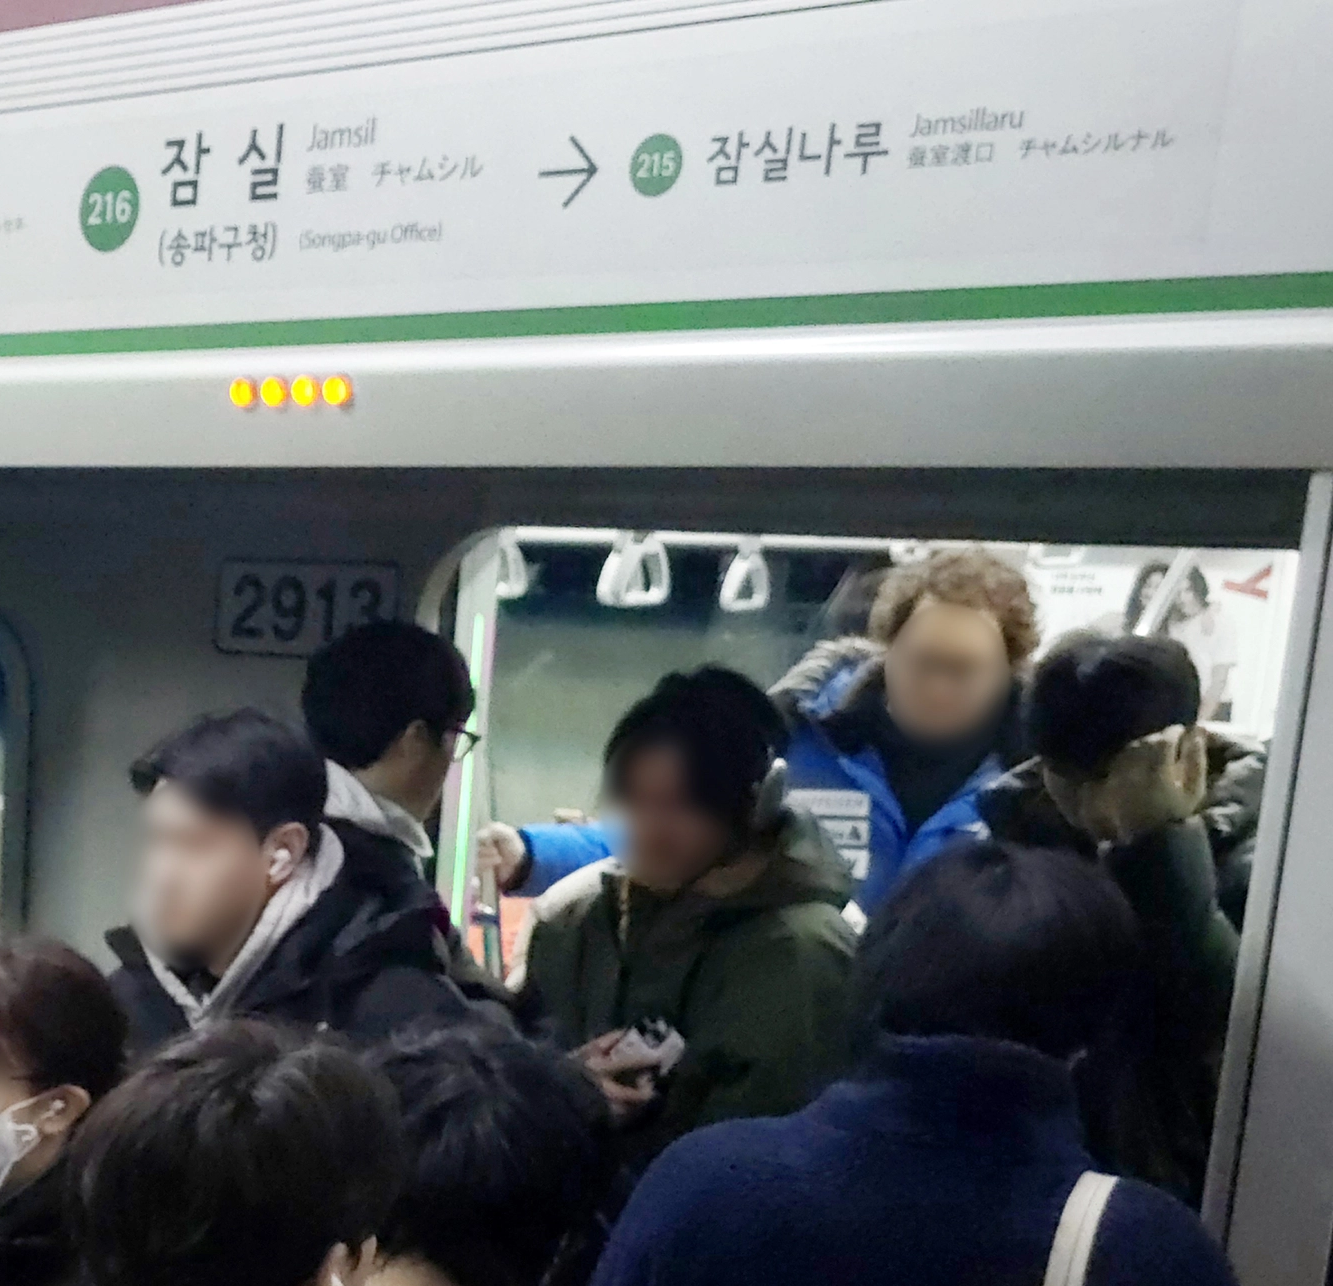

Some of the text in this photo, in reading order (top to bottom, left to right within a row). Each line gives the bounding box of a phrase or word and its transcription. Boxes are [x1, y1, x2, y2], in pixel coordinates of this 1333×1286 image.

[305, 115, 378, 153] Jamsil
[908, 105, 1025, 138] Jamsillaru
[706, 121, 890, 187] 잠실나루
[1020, 127, 1175, 160] チャムシルナル
[370, 153, 484, 189] チャムシル
[635, 151, 677, 179] 215
[86, 189, 133, 226] 216
[157, 222, 279, 268] (송파구청)
[231, 573, 382, 641] 2913
